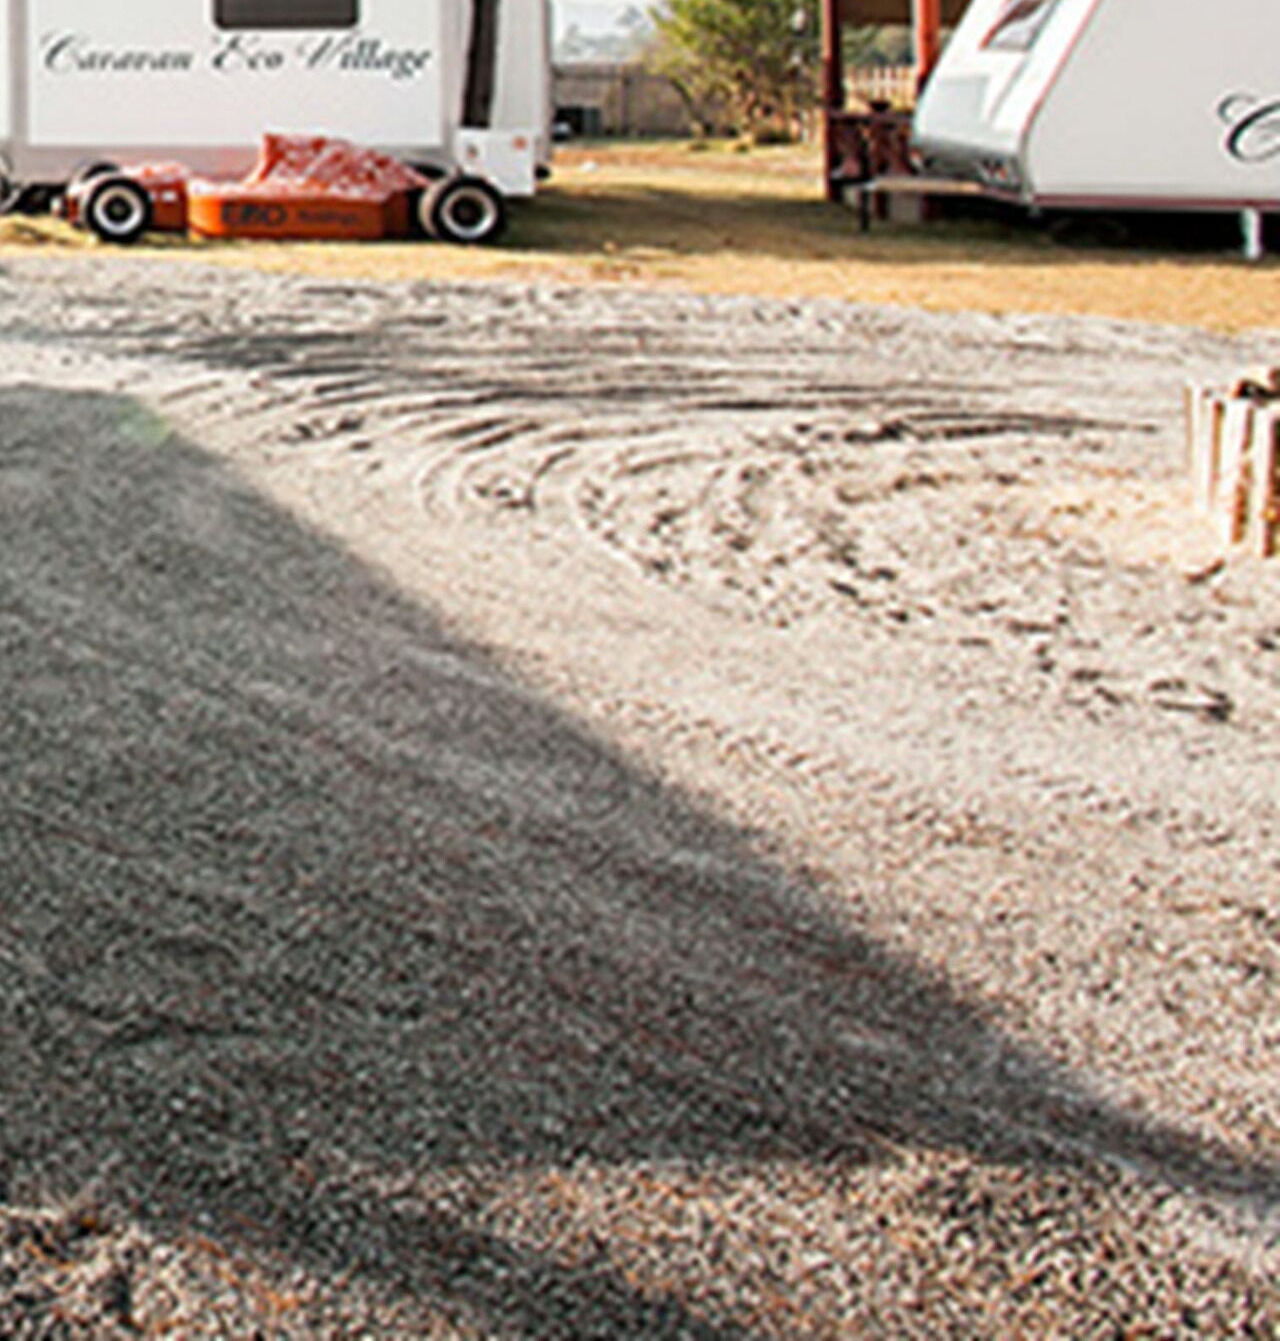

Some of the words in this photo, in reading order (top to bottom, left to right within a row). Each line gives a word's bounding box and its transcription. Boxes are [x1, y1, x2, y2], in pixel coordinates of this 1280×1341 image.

[40, 33, 195, 72] Caravan
[212, 33, 284, 72] Eco
[295, 29, 432, 80] Village
